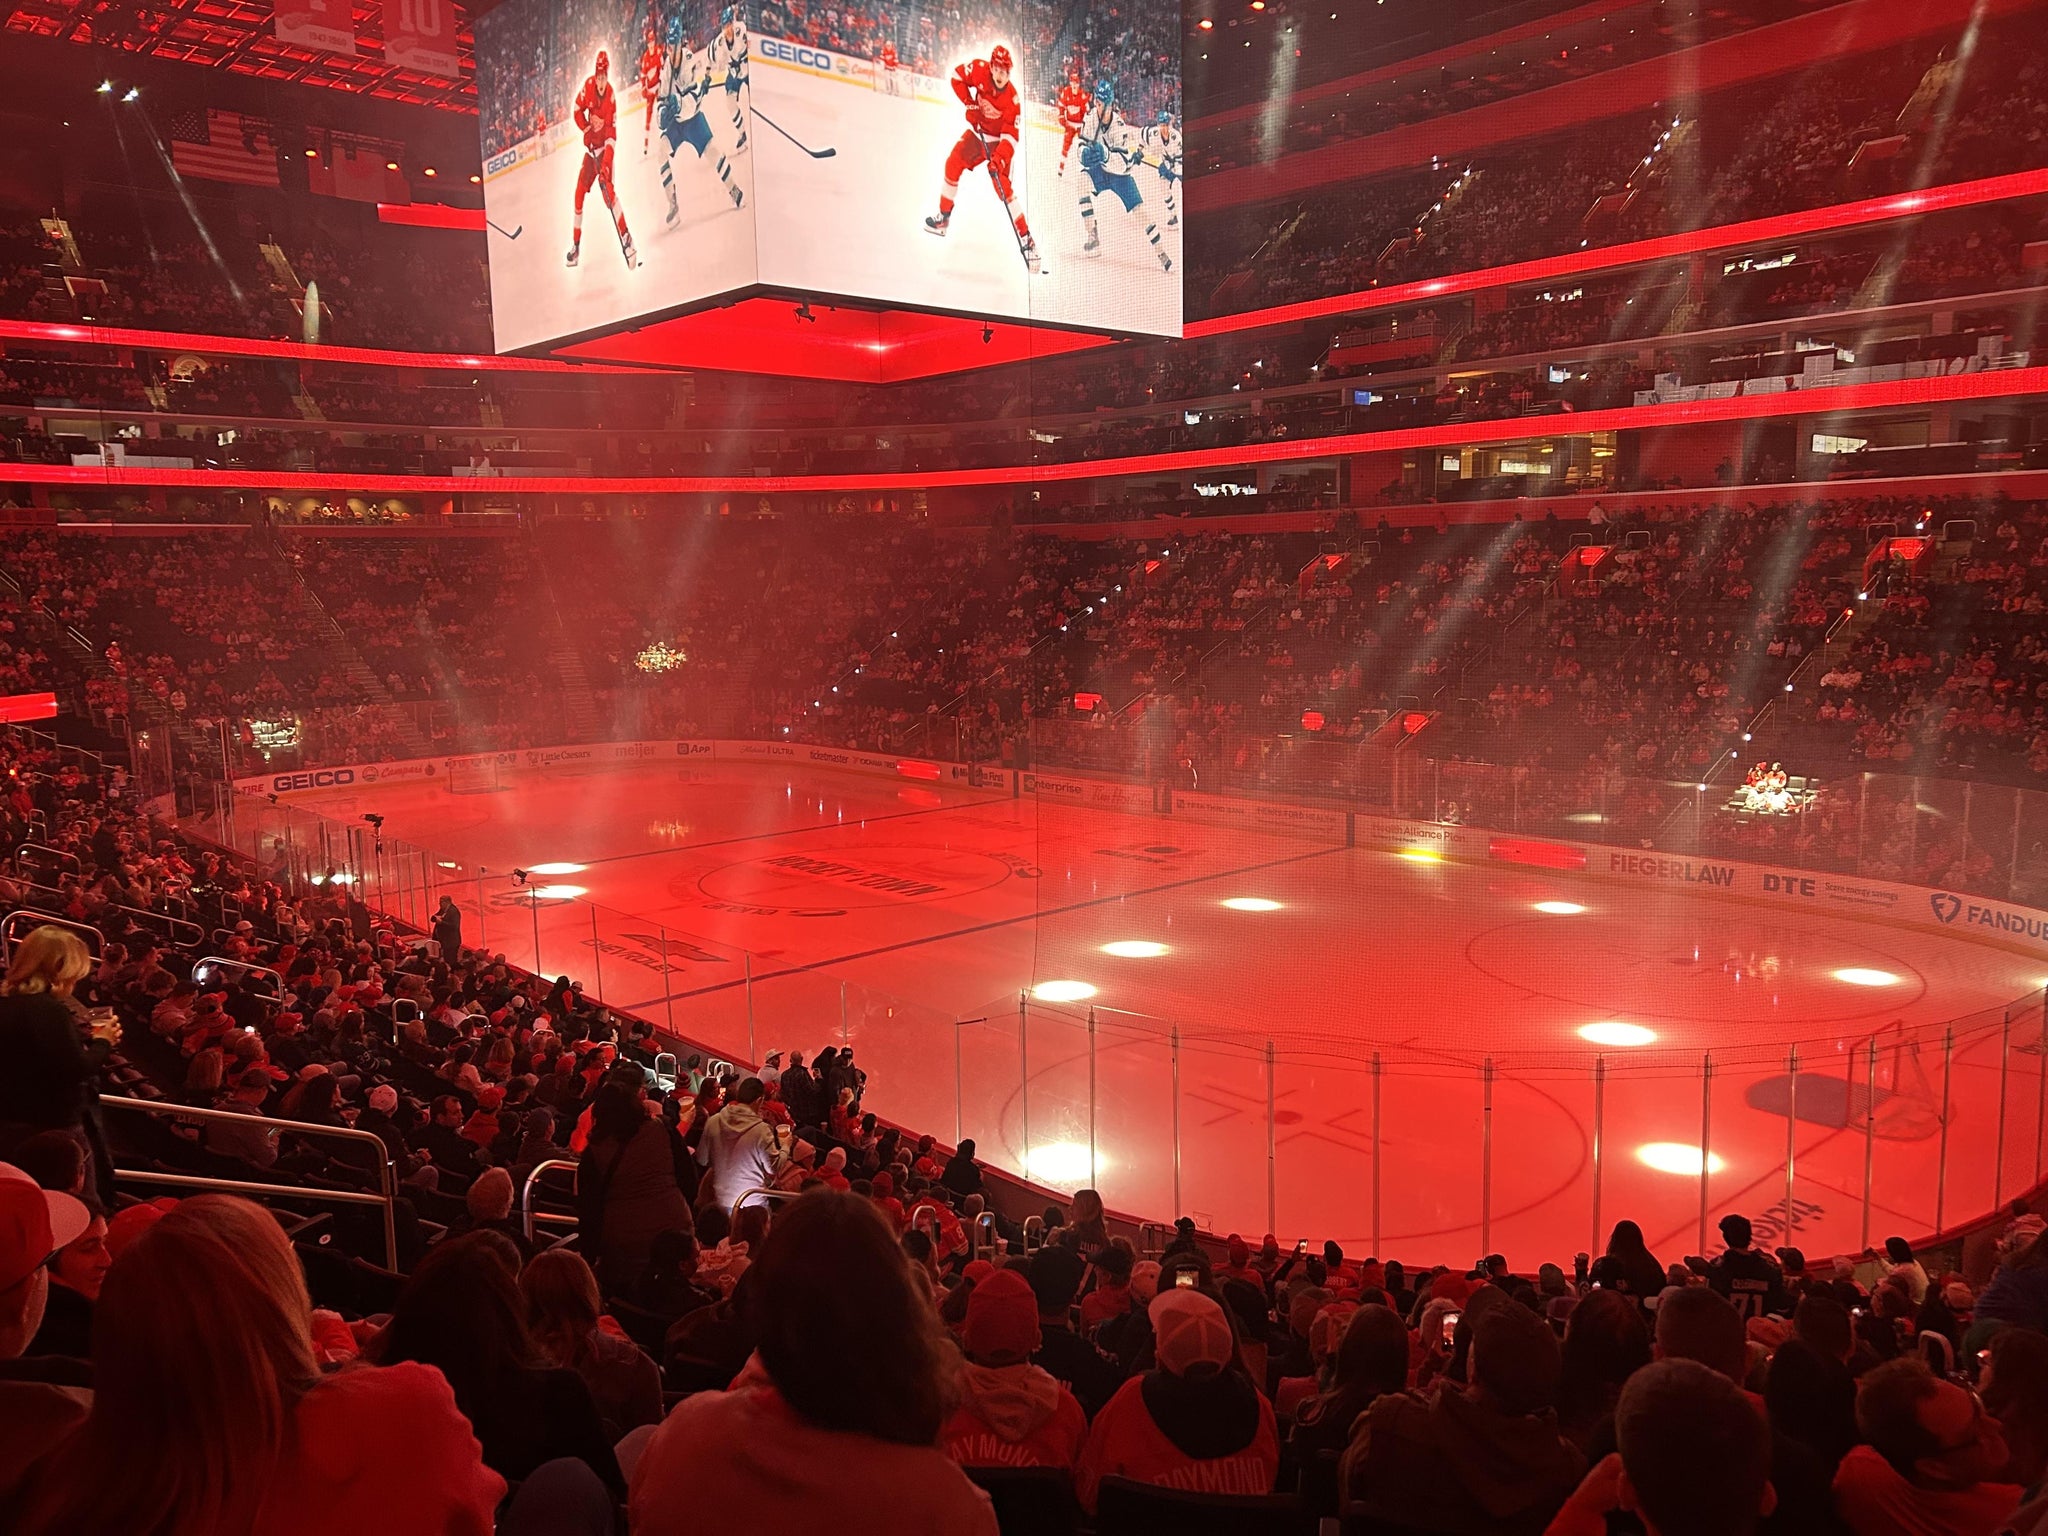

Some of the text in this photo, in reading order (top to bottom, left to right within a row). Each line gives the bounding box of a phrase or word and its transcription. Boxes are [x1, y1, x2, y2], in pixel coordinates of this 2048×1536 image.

[760, 40, 831, 70] GEICO
[487, 149, 516, 175] GEICO
[541, 750, 591, 761] Little Caesars
[615, 743, 656, 759] meijer
[772, 746, 794, 756] ULTRA
[810, 750, 849, 764] ticketmaster
[242, 783, 265, 794] TIRE
[273, 769, 354, 792] GEICO
[1026, 778, 1082, 794] enterprise
[1404, 826, 1442, 840] Alliance
[1444, 831, 1466, 842] Plan
[1763, 873, 1816, 897] DTE
[579, 938, 686, 975] CHEVROLET
[1729, 1293, 1763, 1322] 71
[952, 1433, 1040, 1467] AYMON
